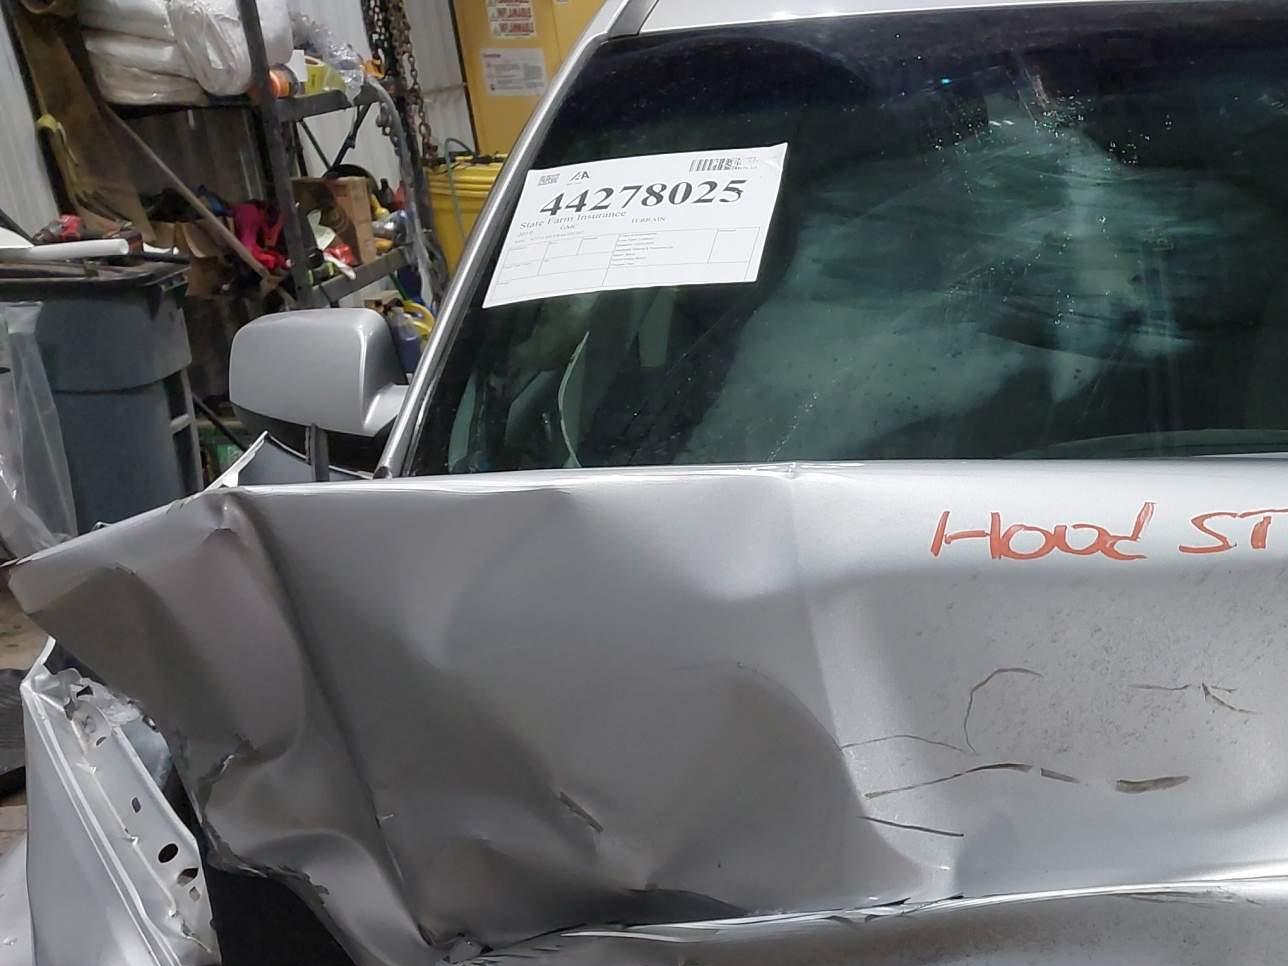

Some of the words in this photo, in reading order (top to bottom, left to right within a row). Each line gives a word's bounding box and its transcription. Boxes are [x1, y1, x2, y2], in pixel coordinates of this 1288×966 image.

[539, 179, 748, 216] 44278025
[519, 220, 545, 230] State
[547, 216, 574, 225] Farm
[577, 210, 627, 222] Insurance
[930, 502, 1155, 560] Hood
